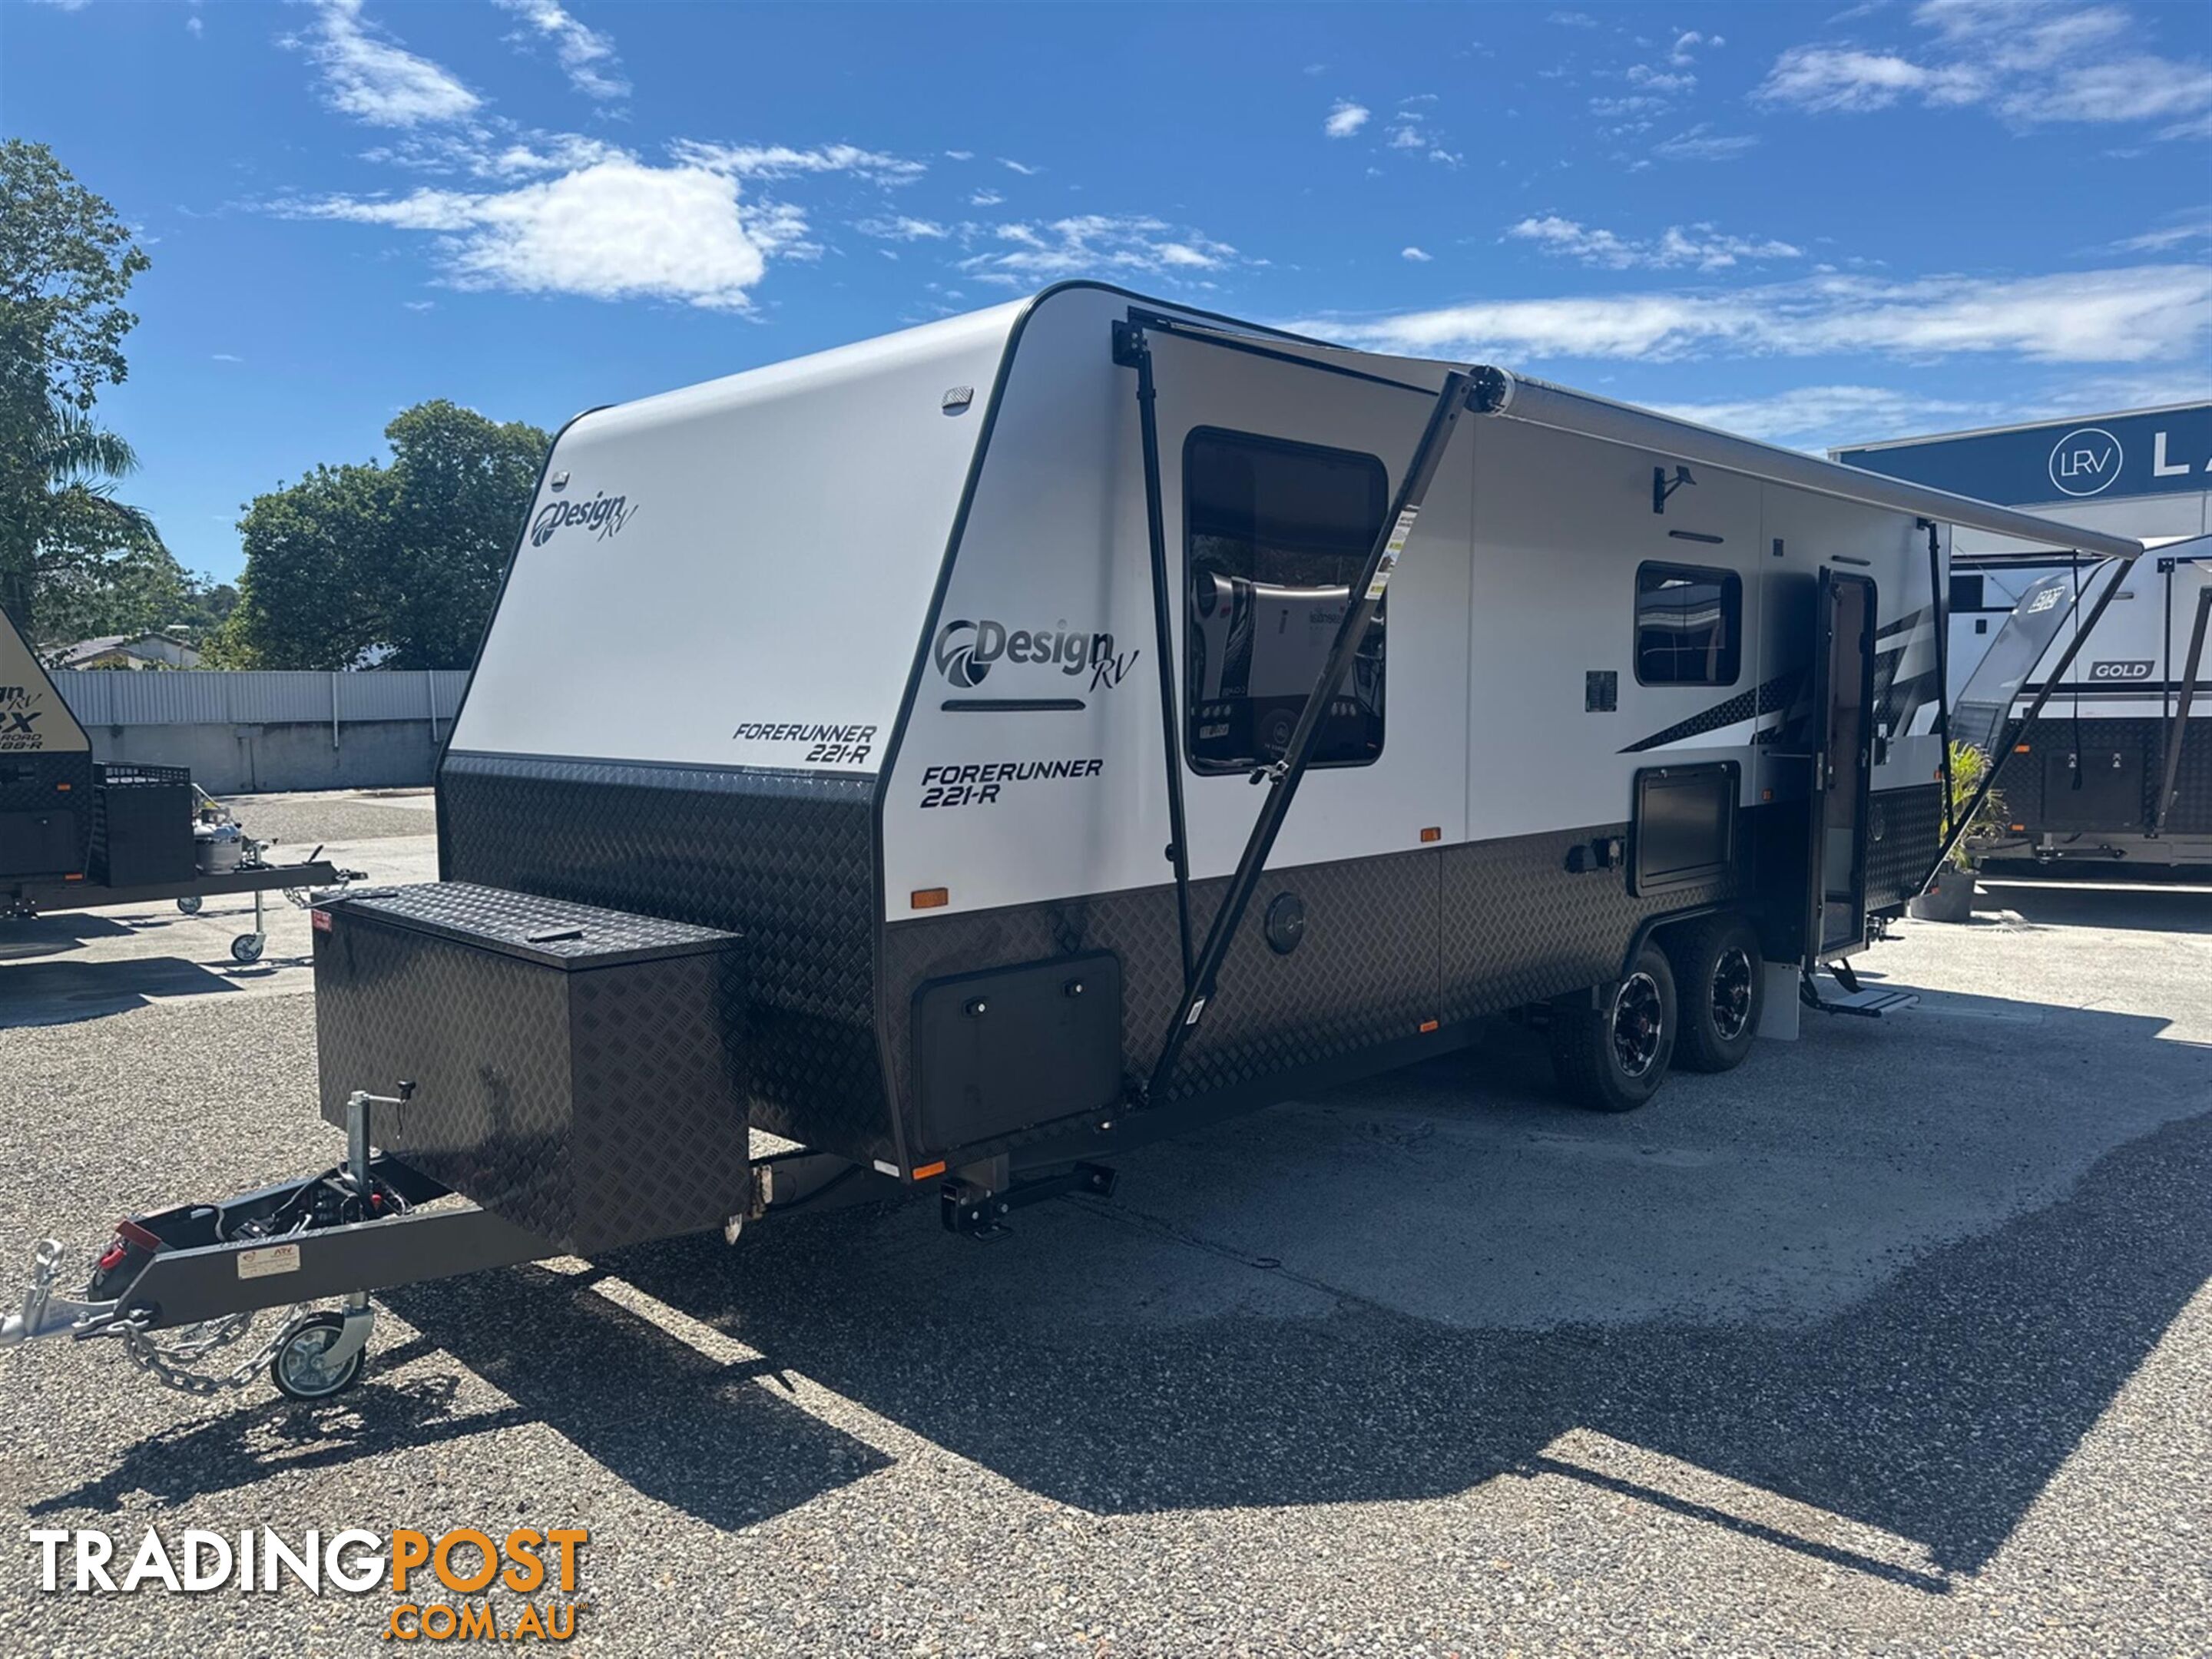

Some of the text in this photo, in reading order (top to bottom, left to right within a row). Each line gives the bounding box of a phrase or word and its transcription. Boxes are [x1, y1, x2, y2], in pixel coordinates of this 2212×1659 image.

[2061, 447, 2111, 477] LRV
[551, 491, 639, 542] Design RV
[975, 619, 1140, 693] Design RV
[2095, 664, 2147, 677] GOLD
[733, 724, 877, 743] FORERUNNER
[805, 743, 872, 764] 221-R
[921, 759, 1104, 786] FORERUNNER
[920, 784, 1001, 808] 221-R
